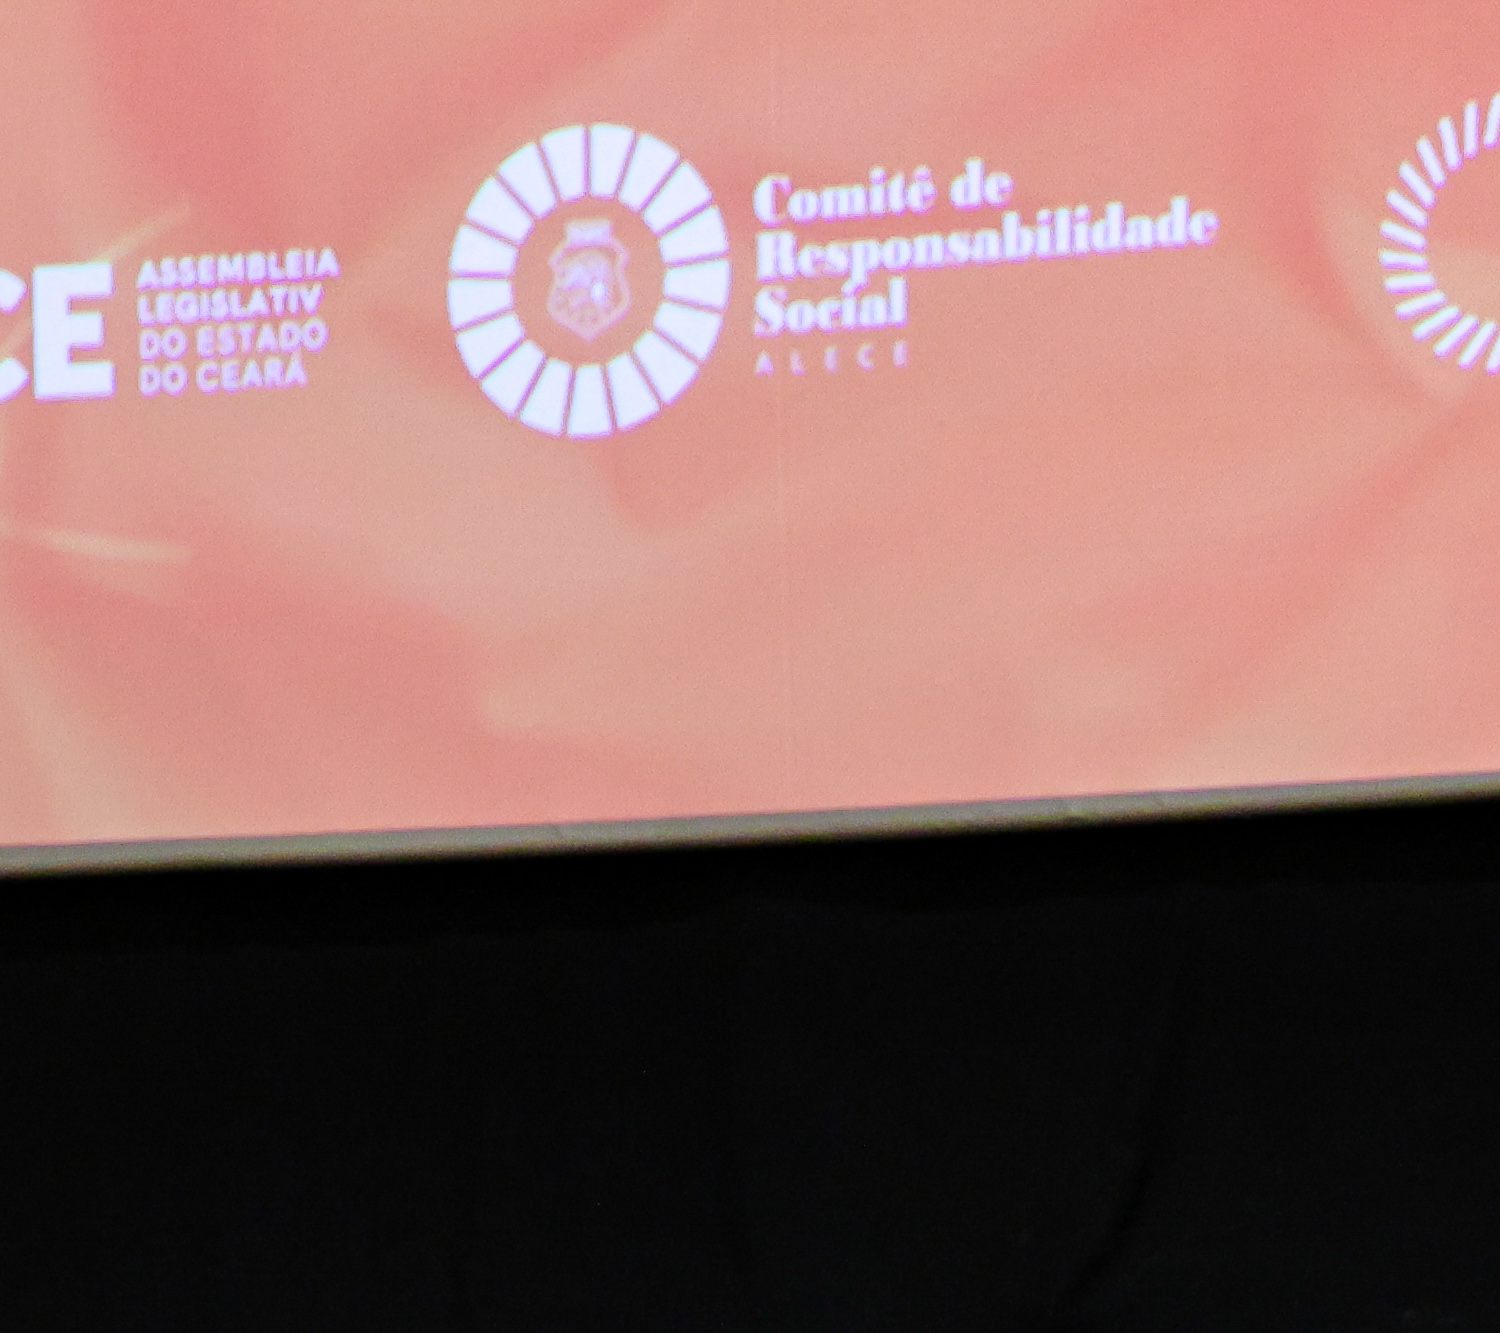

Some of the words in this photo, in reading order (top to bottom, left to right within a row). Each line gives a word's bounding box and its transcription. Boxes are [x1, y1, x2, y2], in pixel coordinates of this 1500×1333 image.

[950, 158, 1014, 209] de
[756, 196, 1220, 288] Responsabilidade
[137, 247, 341, 291] ASSEMBLEIA
[753, 276, 908, 336] Social
[139, 327, 189, 362] DO
[195, 317, 330, 359] ESTADO
[139, 361, 189, 397] DO
